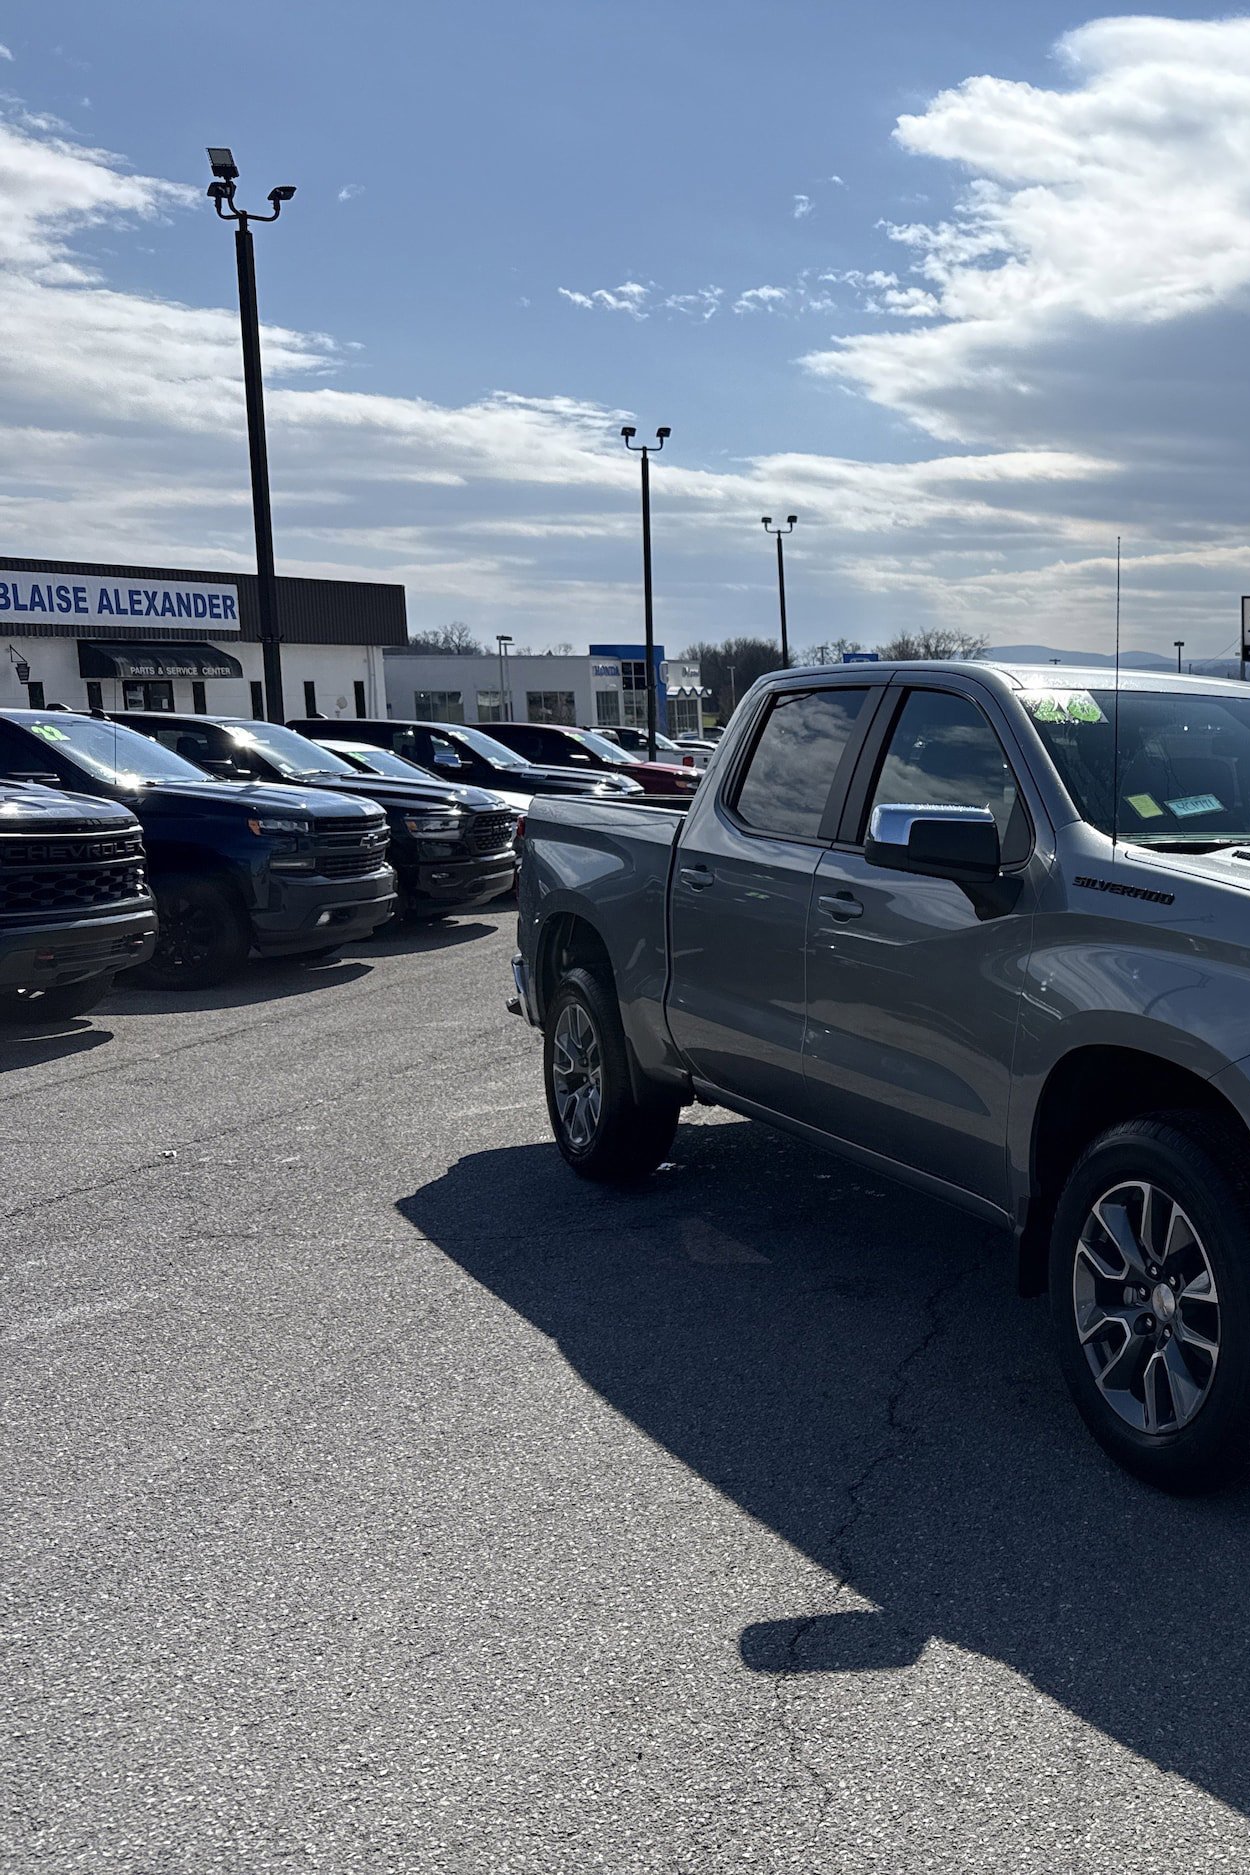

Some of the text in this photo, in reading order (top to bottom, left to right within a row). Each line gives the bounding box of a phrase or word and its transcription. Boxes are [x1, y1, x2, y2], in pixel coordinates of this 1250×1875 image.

[0, 582, 238, 620] BLAISE ALEXANDER
[130, 666, 231, 676] PARTS & SERVICE CENTER
[592, 664, 620, 677] HONDA
[1072, 876, 1176, 906] SILVERADO
